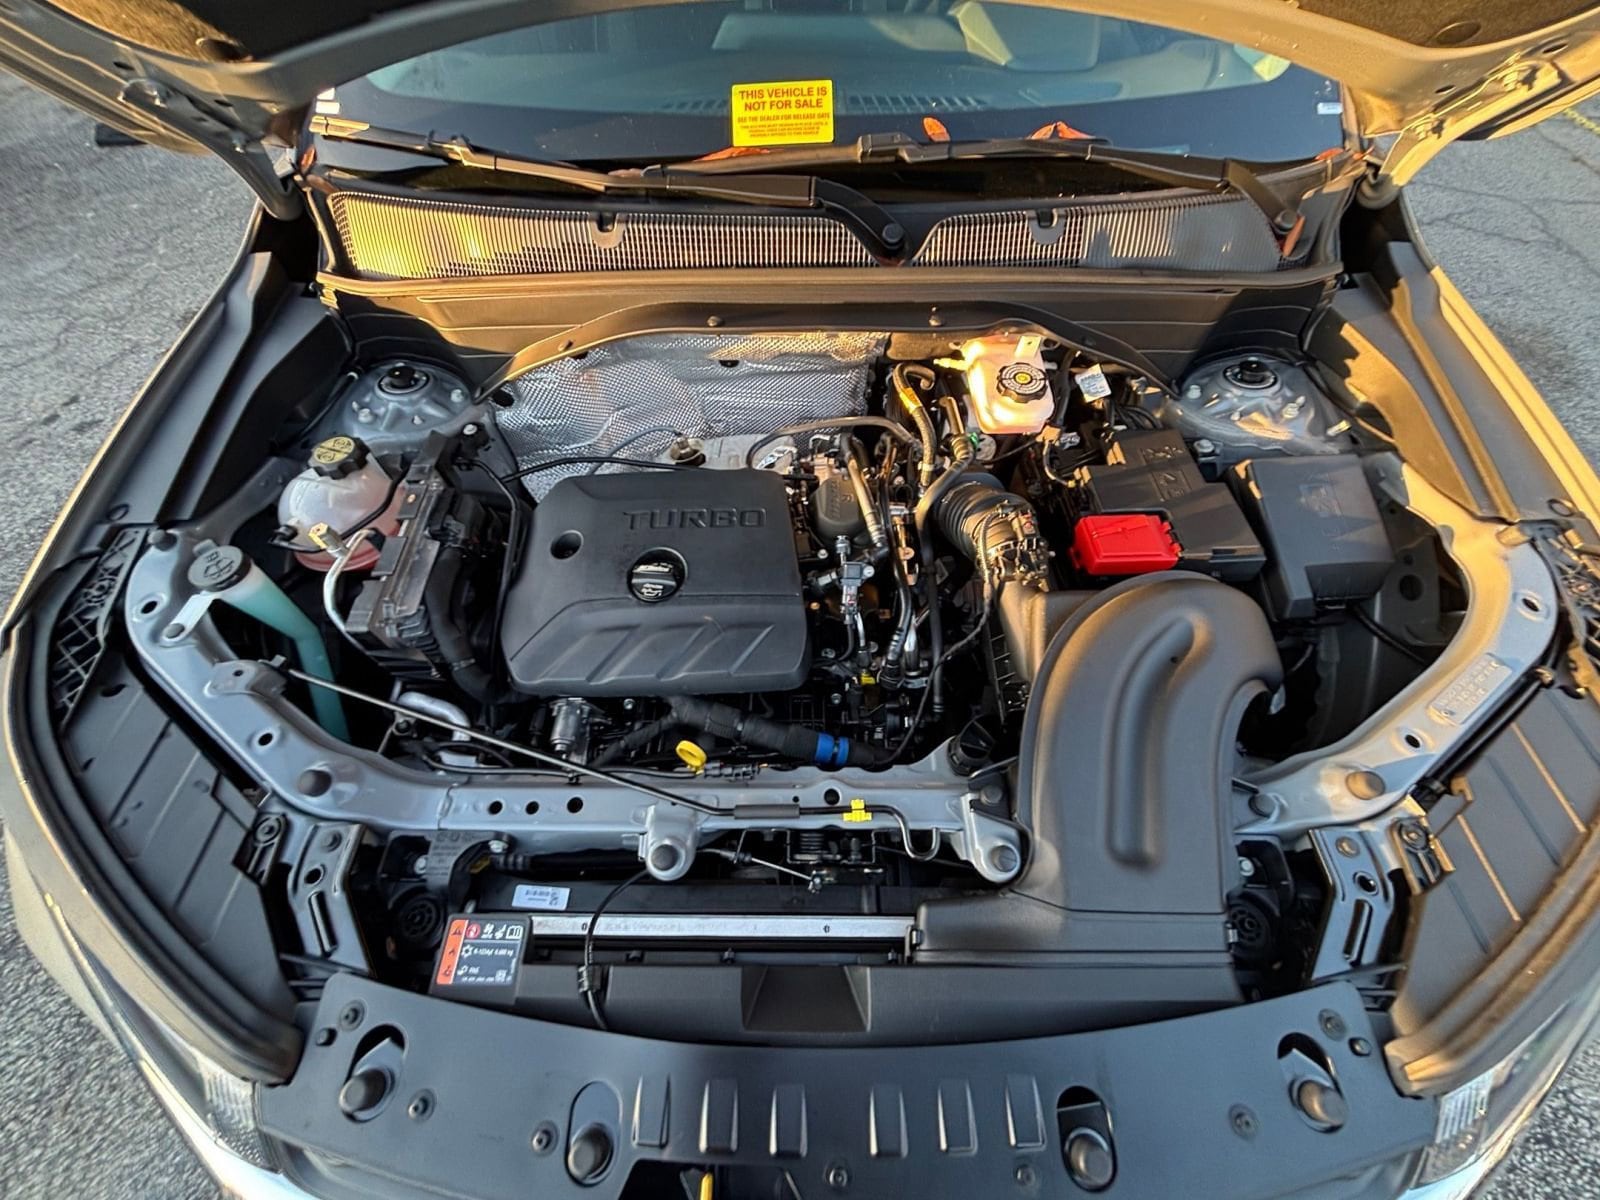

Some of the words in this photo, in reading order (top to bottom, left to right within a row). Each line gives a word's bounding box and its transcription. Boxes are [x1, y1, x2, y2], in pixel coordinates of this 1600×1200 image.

[739, 89, 764, 99] THIS
[767, 87, 814, 98] VEHICLE
[817, 86, 827, 96] IS
[744, 101, 766, 111] NOT
[769, 99, 792, 110] FOR
[795, 98, 823, 109] SALE
[760, 114, 780, 122] DEALER
[623, 508, 767, 530] TURBO
